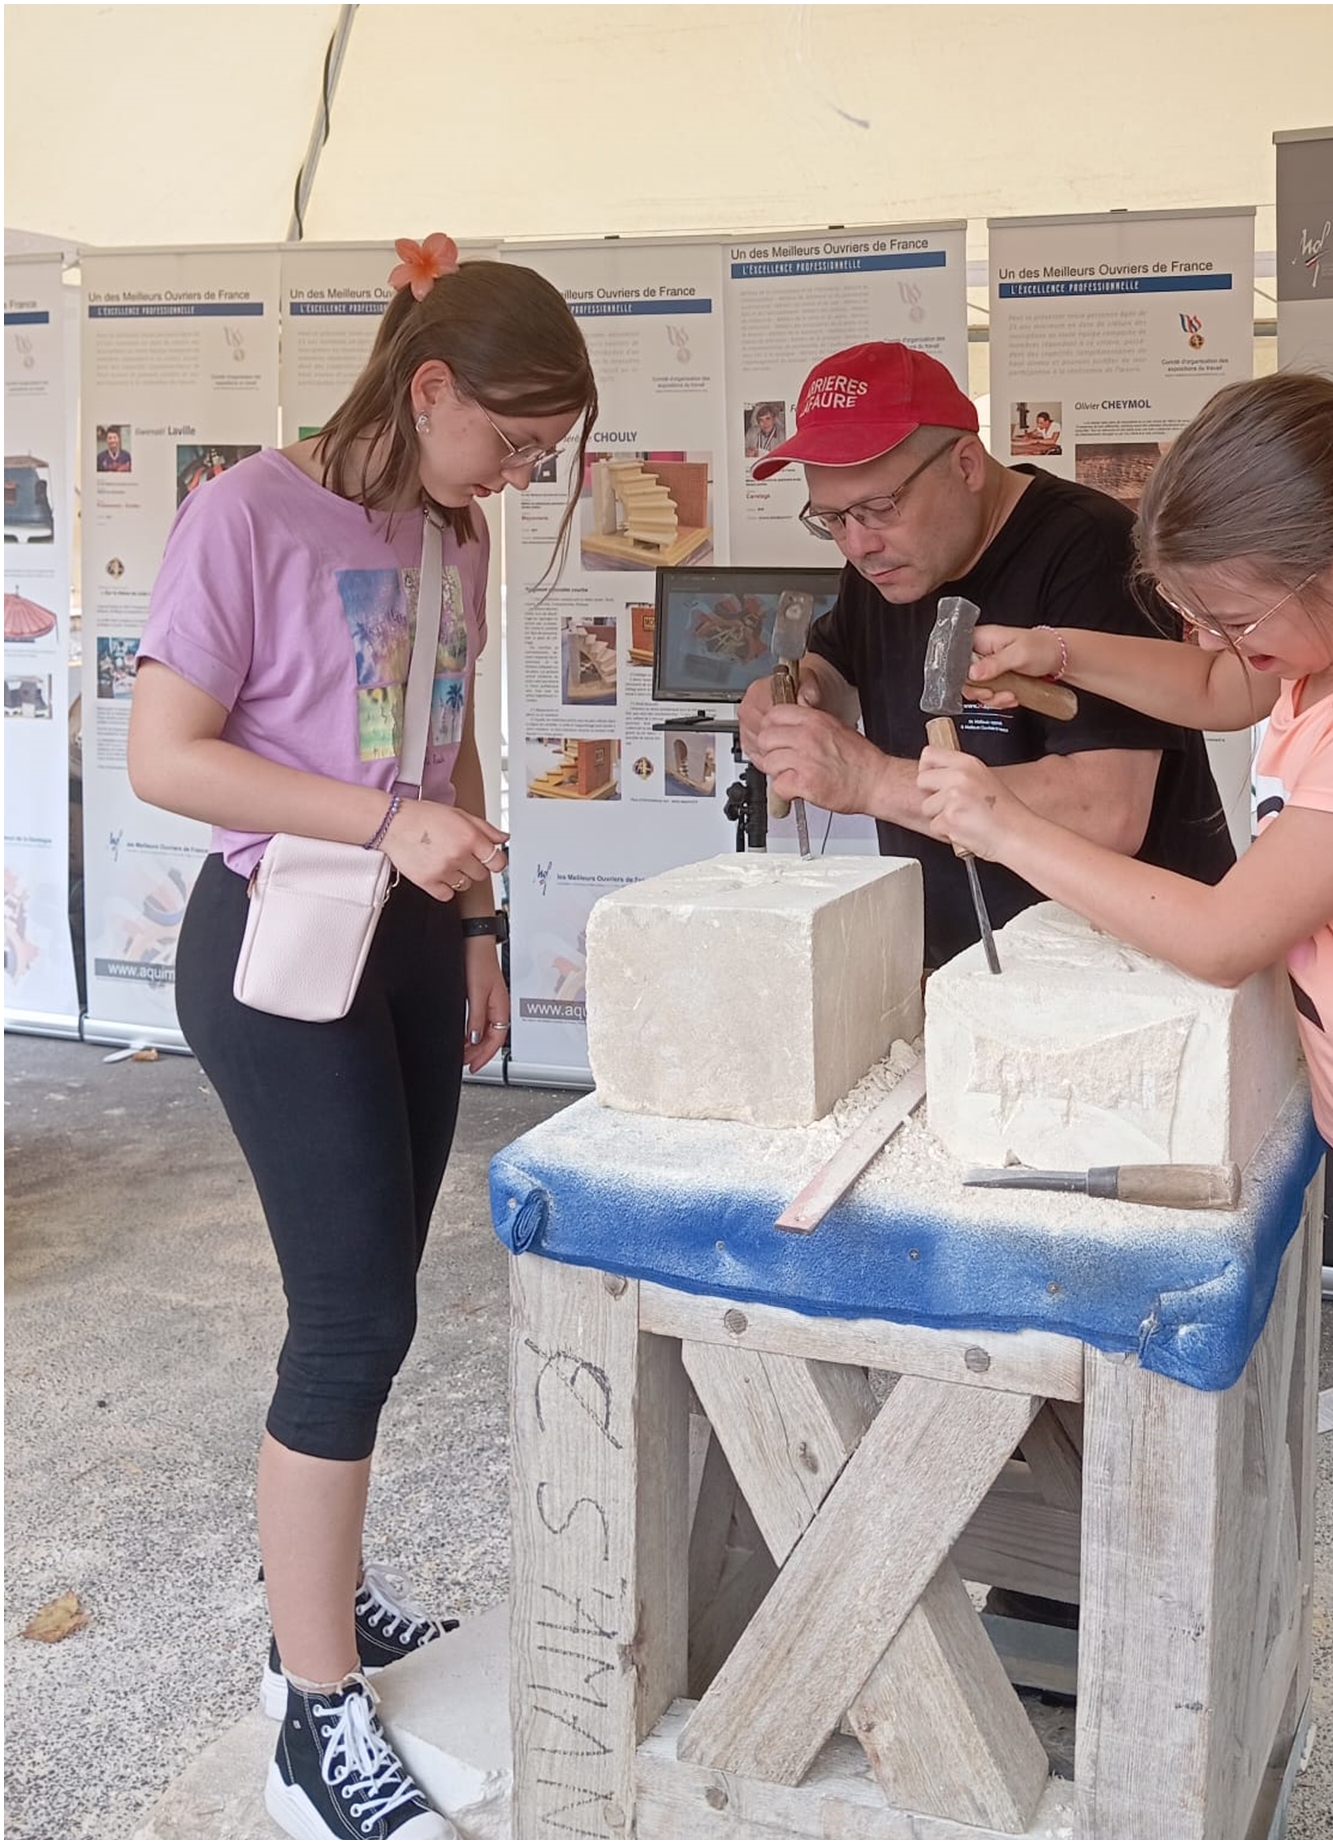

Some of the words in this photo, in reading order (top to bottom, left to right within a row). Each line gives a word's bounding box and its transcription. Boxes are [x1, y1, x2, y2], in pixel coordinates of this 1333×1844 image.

[731, 249, 746, 261] Un
[749, 248, 768, 260] des
[772, 244, 820, 258] Meilleurs
[824, 242, 870, 255] Ouvriers
[872, 240, 886, 252] de
[890, 238, 929, 250] France
[999, 268, 1014, 280] Un
[1018, 267, 1040, 279] des
[1043, 265, 1095, 278] Meilleurs
[1099, 264, 1149, 276] Ouvriers
[1152, 262, 1168, 274] de
[1171, 260, 1213, 272] France
[88, 292, 100, 302] Un
[103, 292, 120, 302] des
[122, 292, 162, 302] Meilleurs
[164, 290, 201, 301] Ouvriers
[204, 290, 216, 300] de
[218, 290, 250, 300] France
[290, 290, 304, 299] Un
[307, 289, 324, 298] des
[328, 288, 371, 298] Meilleurs
[596, 288, 640, 299] Ouvriers
[643, 286, 656, 297] de
[659, 286, 695, 297] France
[1074, 401, 1100, 411] Olivier
[1101, 399, 1152, 410] CHEYMOL
[168, 425, 196, 436] Laville
[594, 432, 638, 443] CHOULY
